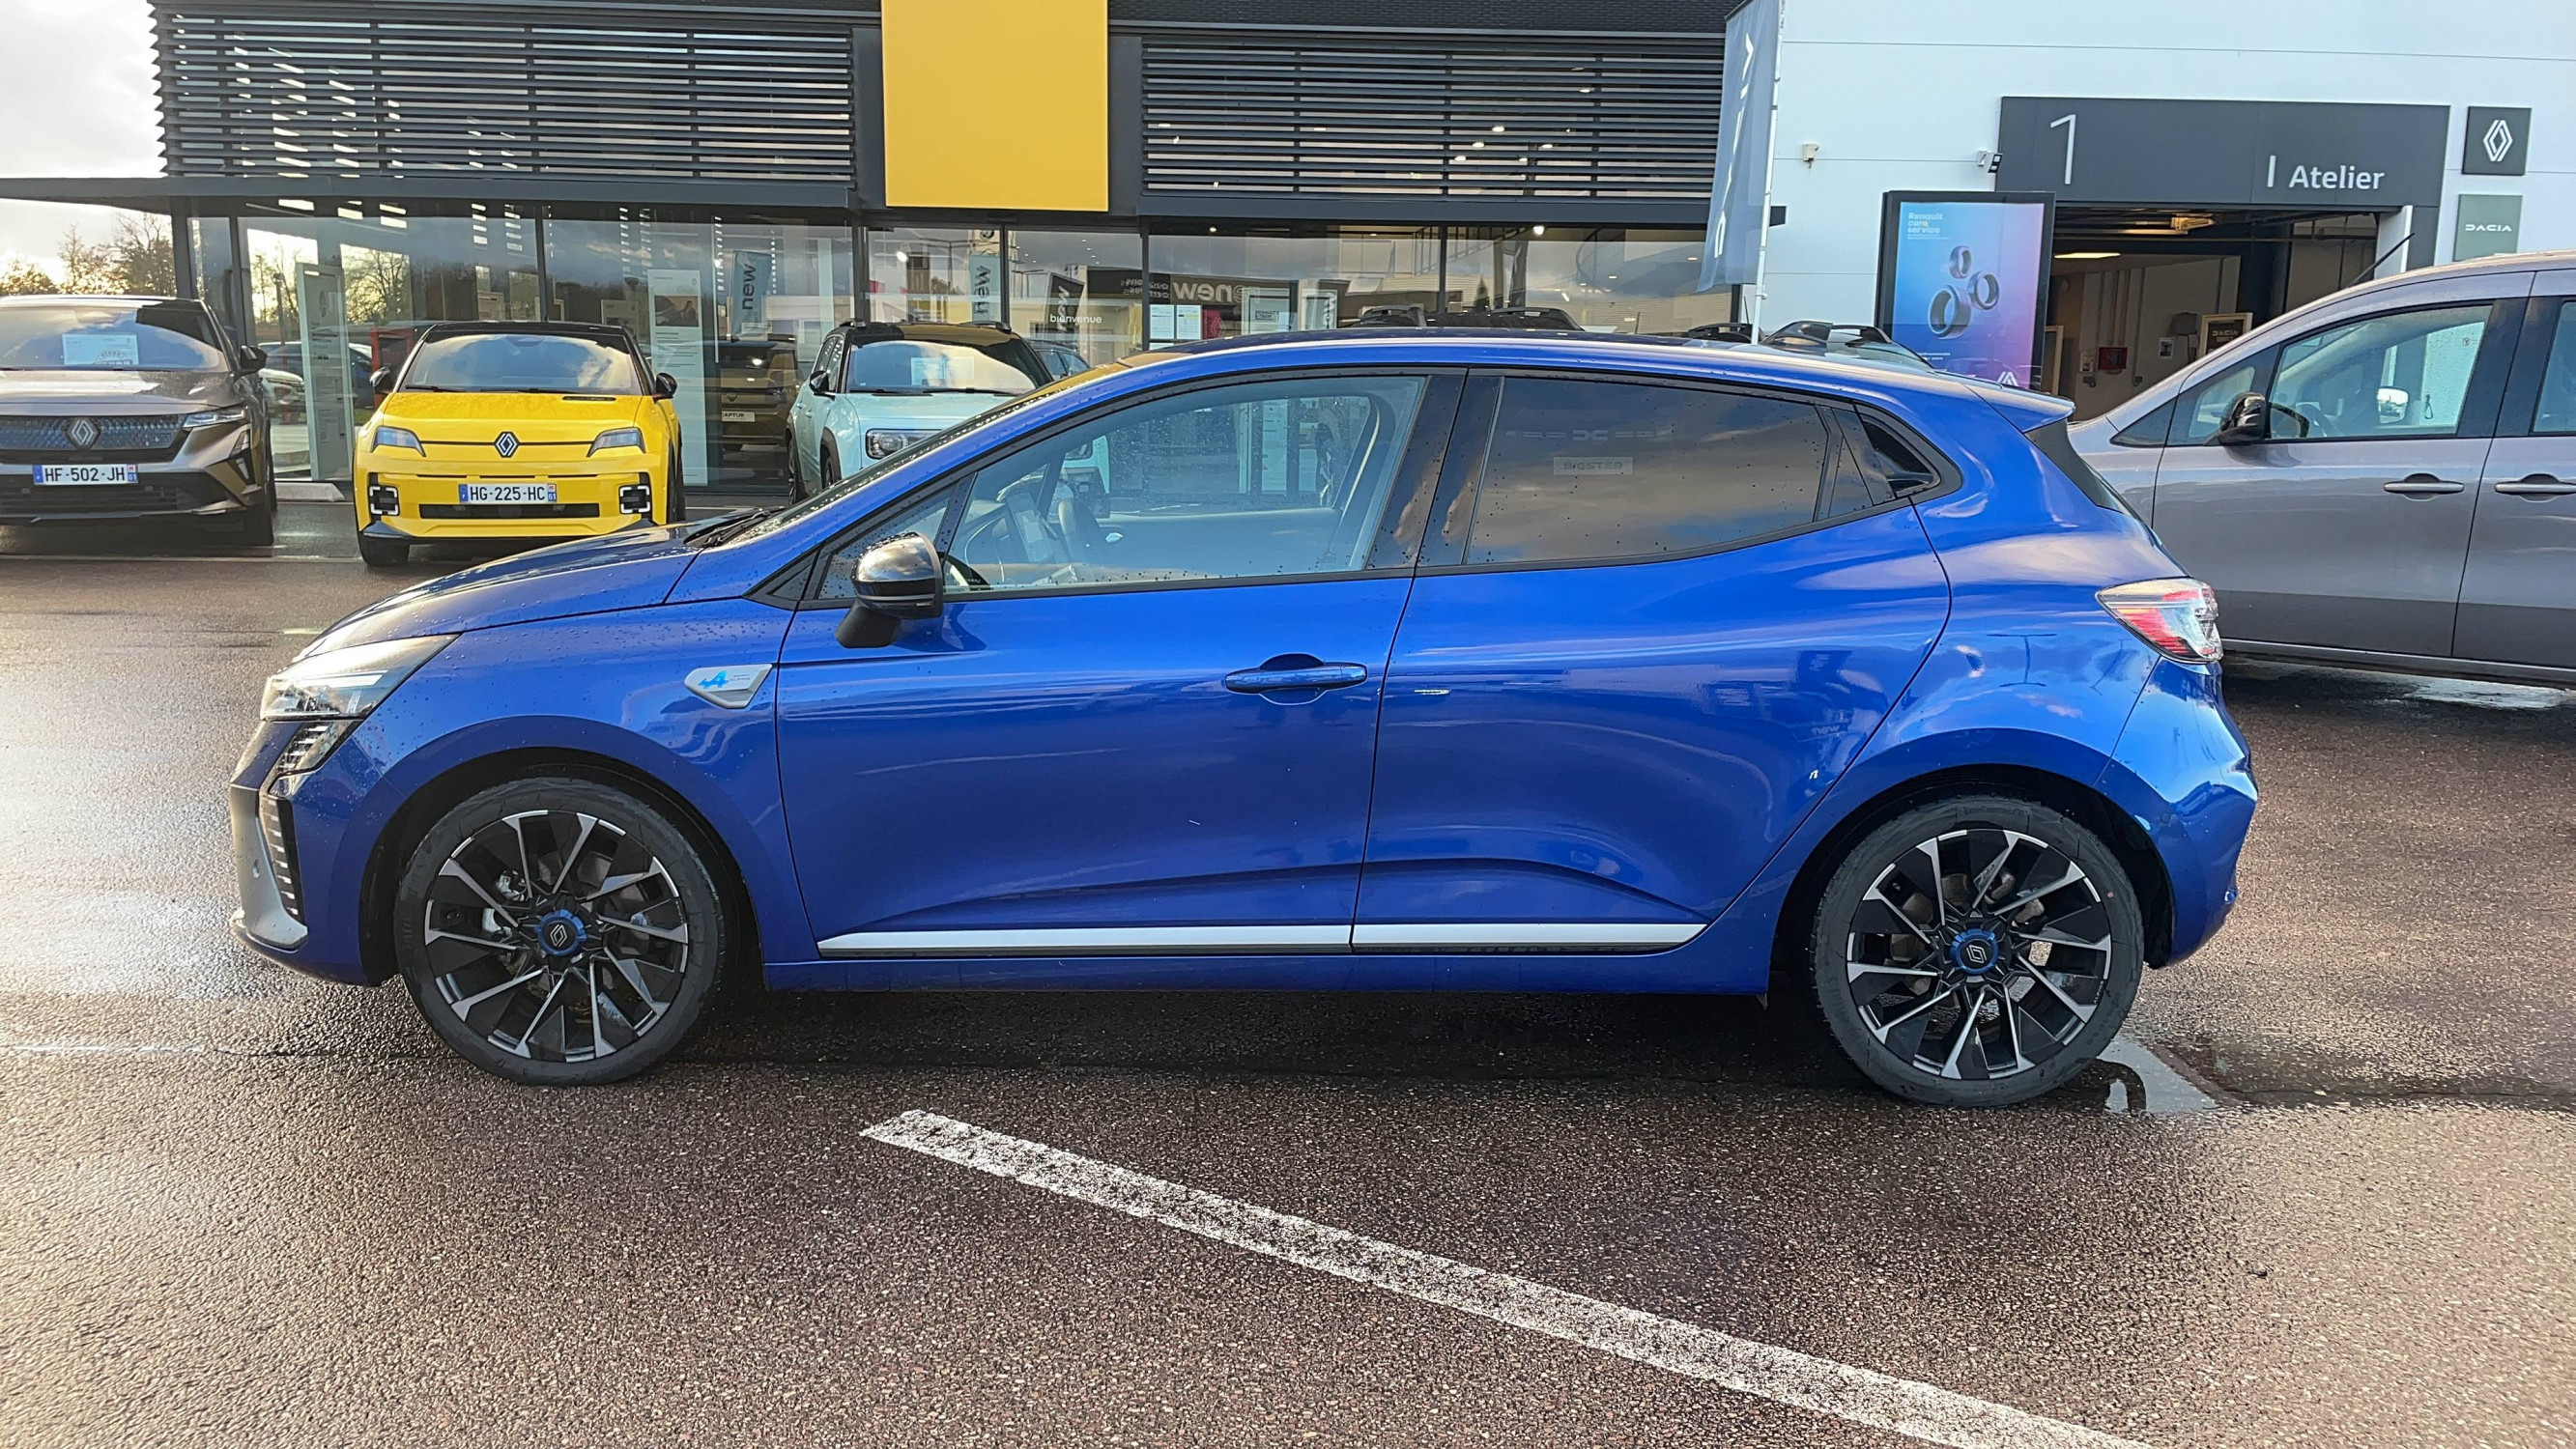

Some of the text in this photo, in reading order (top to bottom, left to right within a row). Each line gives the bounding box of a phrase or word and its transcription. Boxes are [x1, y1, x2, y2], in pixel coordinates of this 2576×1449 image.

[2049, 113, 2077, 185] 1
[2288, 164, 2386, 190] Atelier
[1907, 212, 1943, 220] Renault
[2464, 223, 2513, 233] DACIA
[741, 263, 757, 310] new
[1049, 313, 1102, 324] bienvenue
[1563, 461, 1623, 470] BIGSTER
[44, 467, 126, 482] HF-502-JH
[470, 486, 545, 501] HG-225-HC
